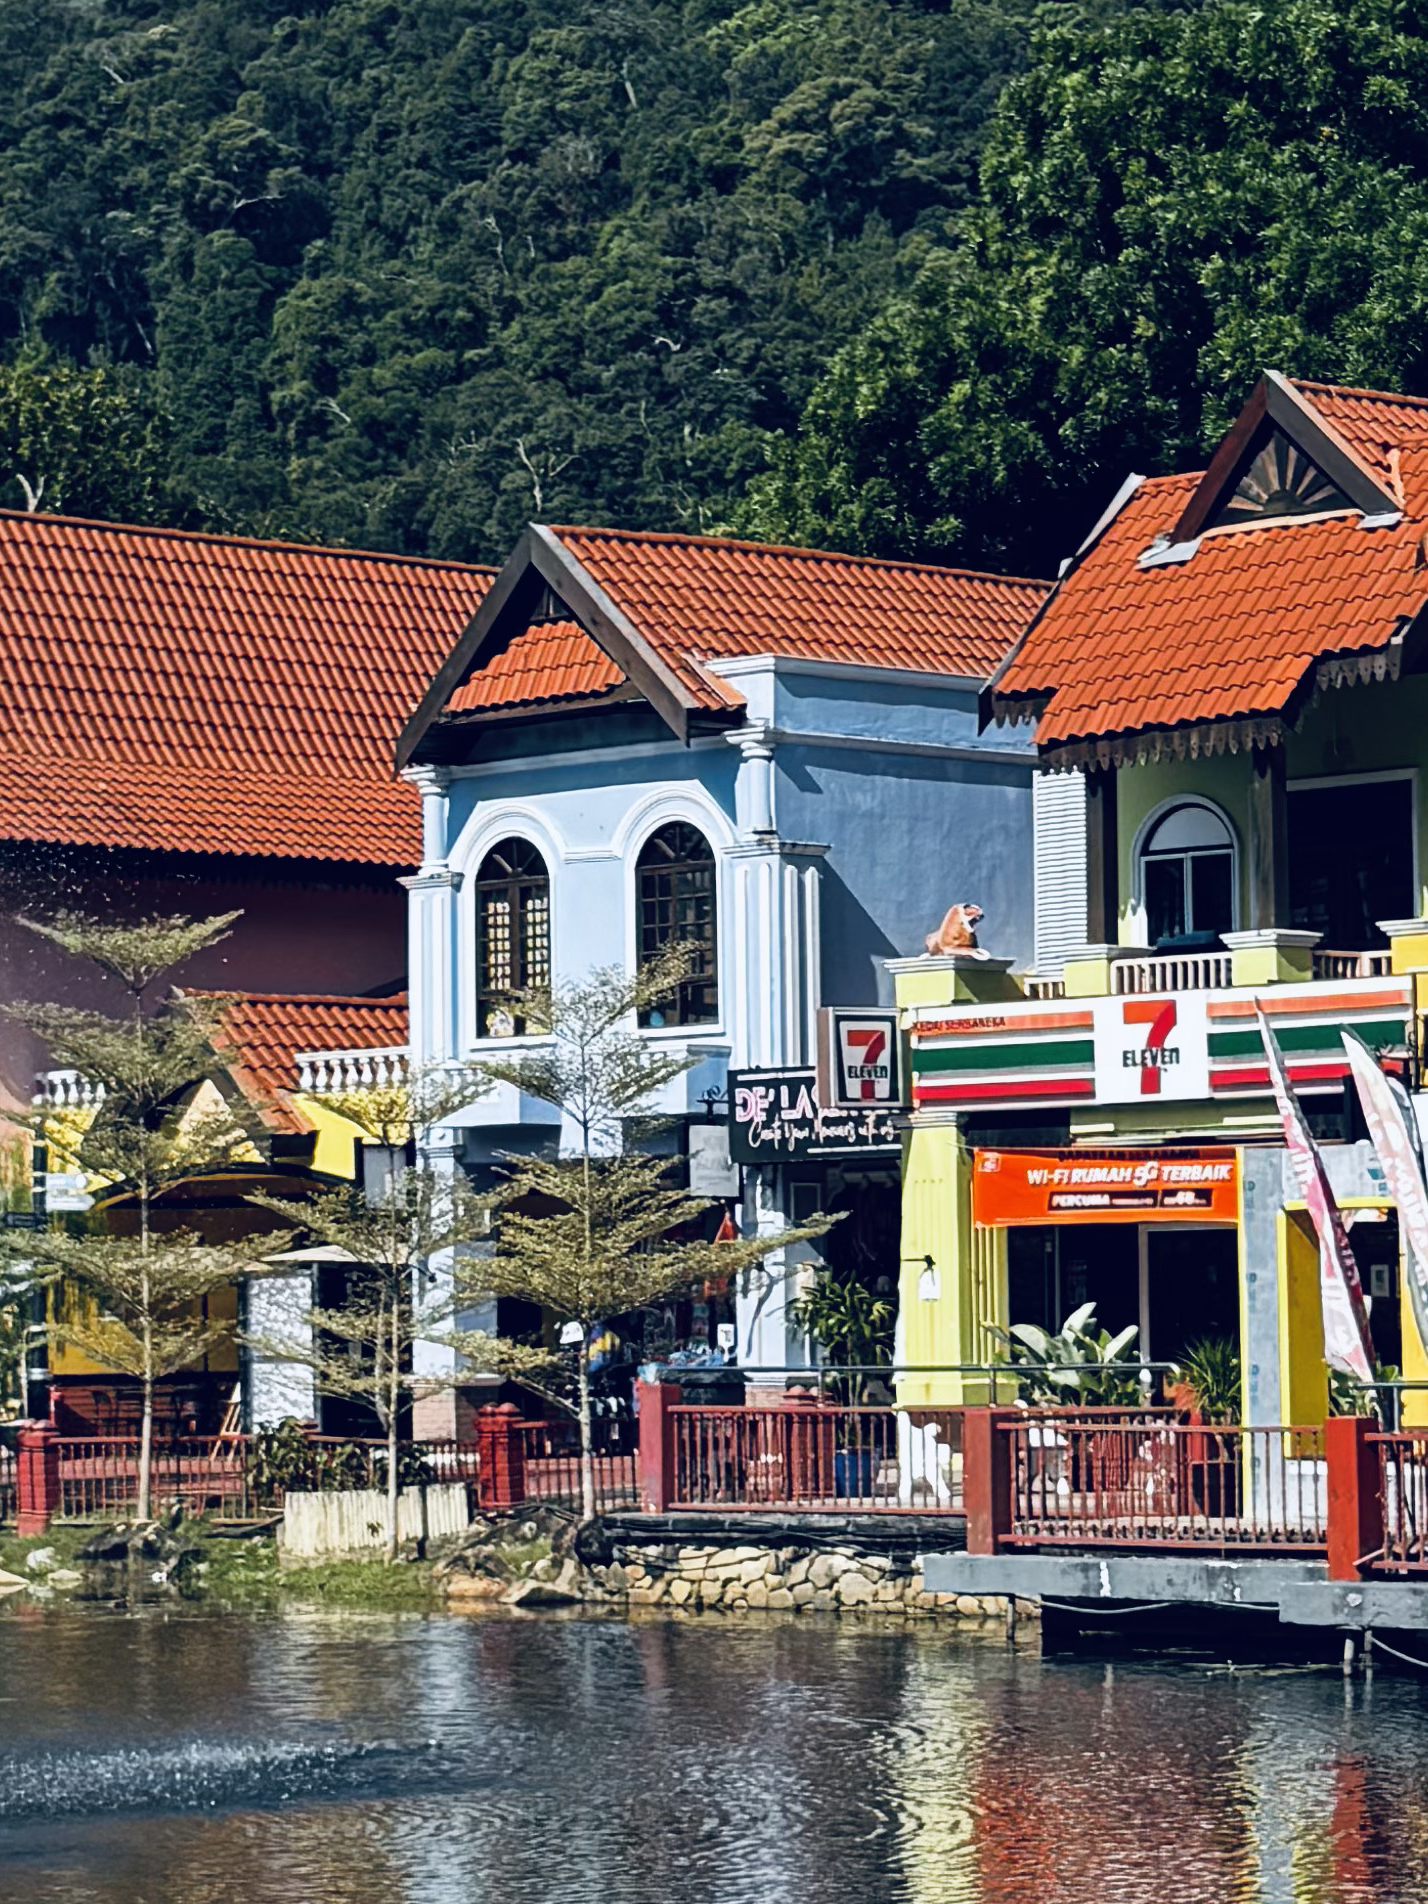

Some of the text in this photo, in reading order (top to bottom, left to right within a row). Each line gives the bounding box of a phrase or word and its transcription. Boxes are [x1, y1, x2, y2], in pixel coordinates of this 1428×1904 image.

[945, 1016, 1006, 1031] SERBANEKA
[1123, 999, 1177, 1095] 7
[846, 1029, 886, 1101] 7
[1027, 1160, 1234, 1187] WI-FI RUMAH 5G TERBAIK
